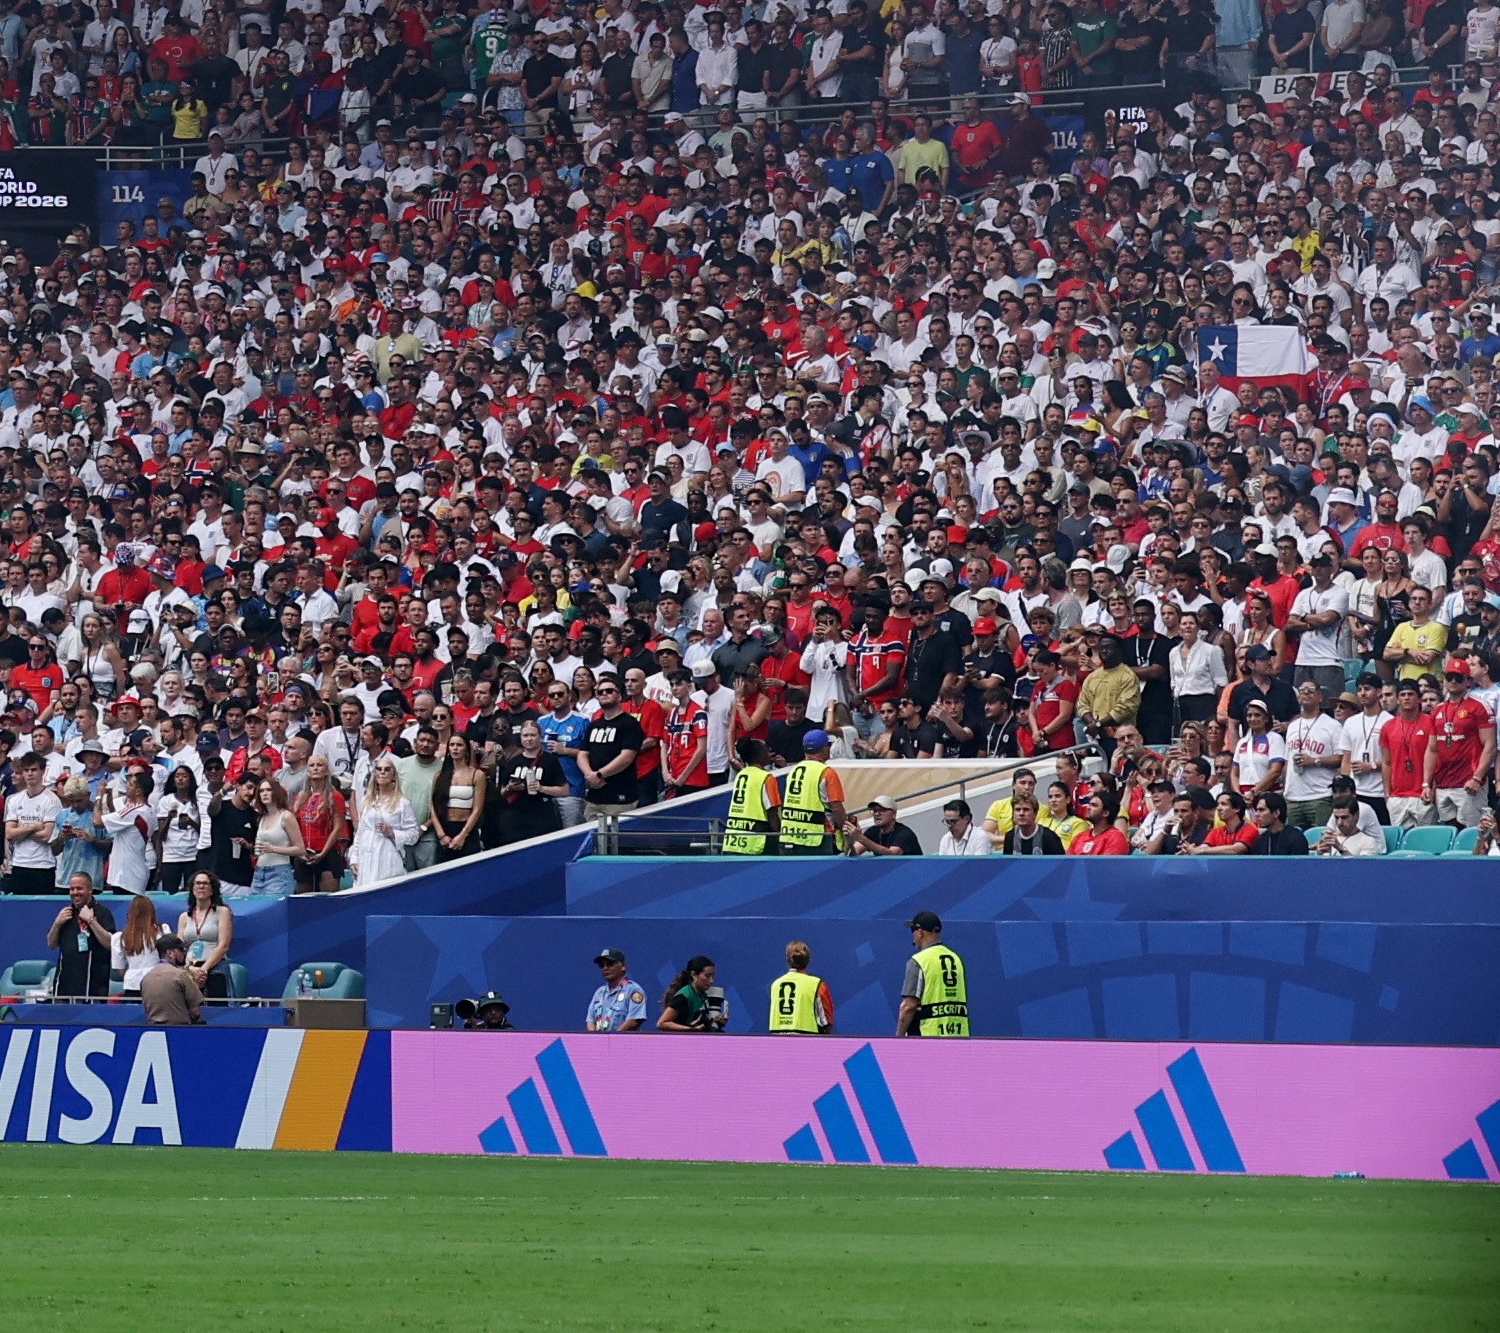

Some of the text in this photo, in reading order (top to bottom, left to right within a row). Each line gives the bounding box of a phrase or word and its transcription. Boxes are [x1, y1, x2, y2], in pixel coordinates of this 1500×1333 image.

[1120, 108, 1146, 120] FIFA
[112, 185, 145, 203] 114
[14, 195, 68, 208] 2026
